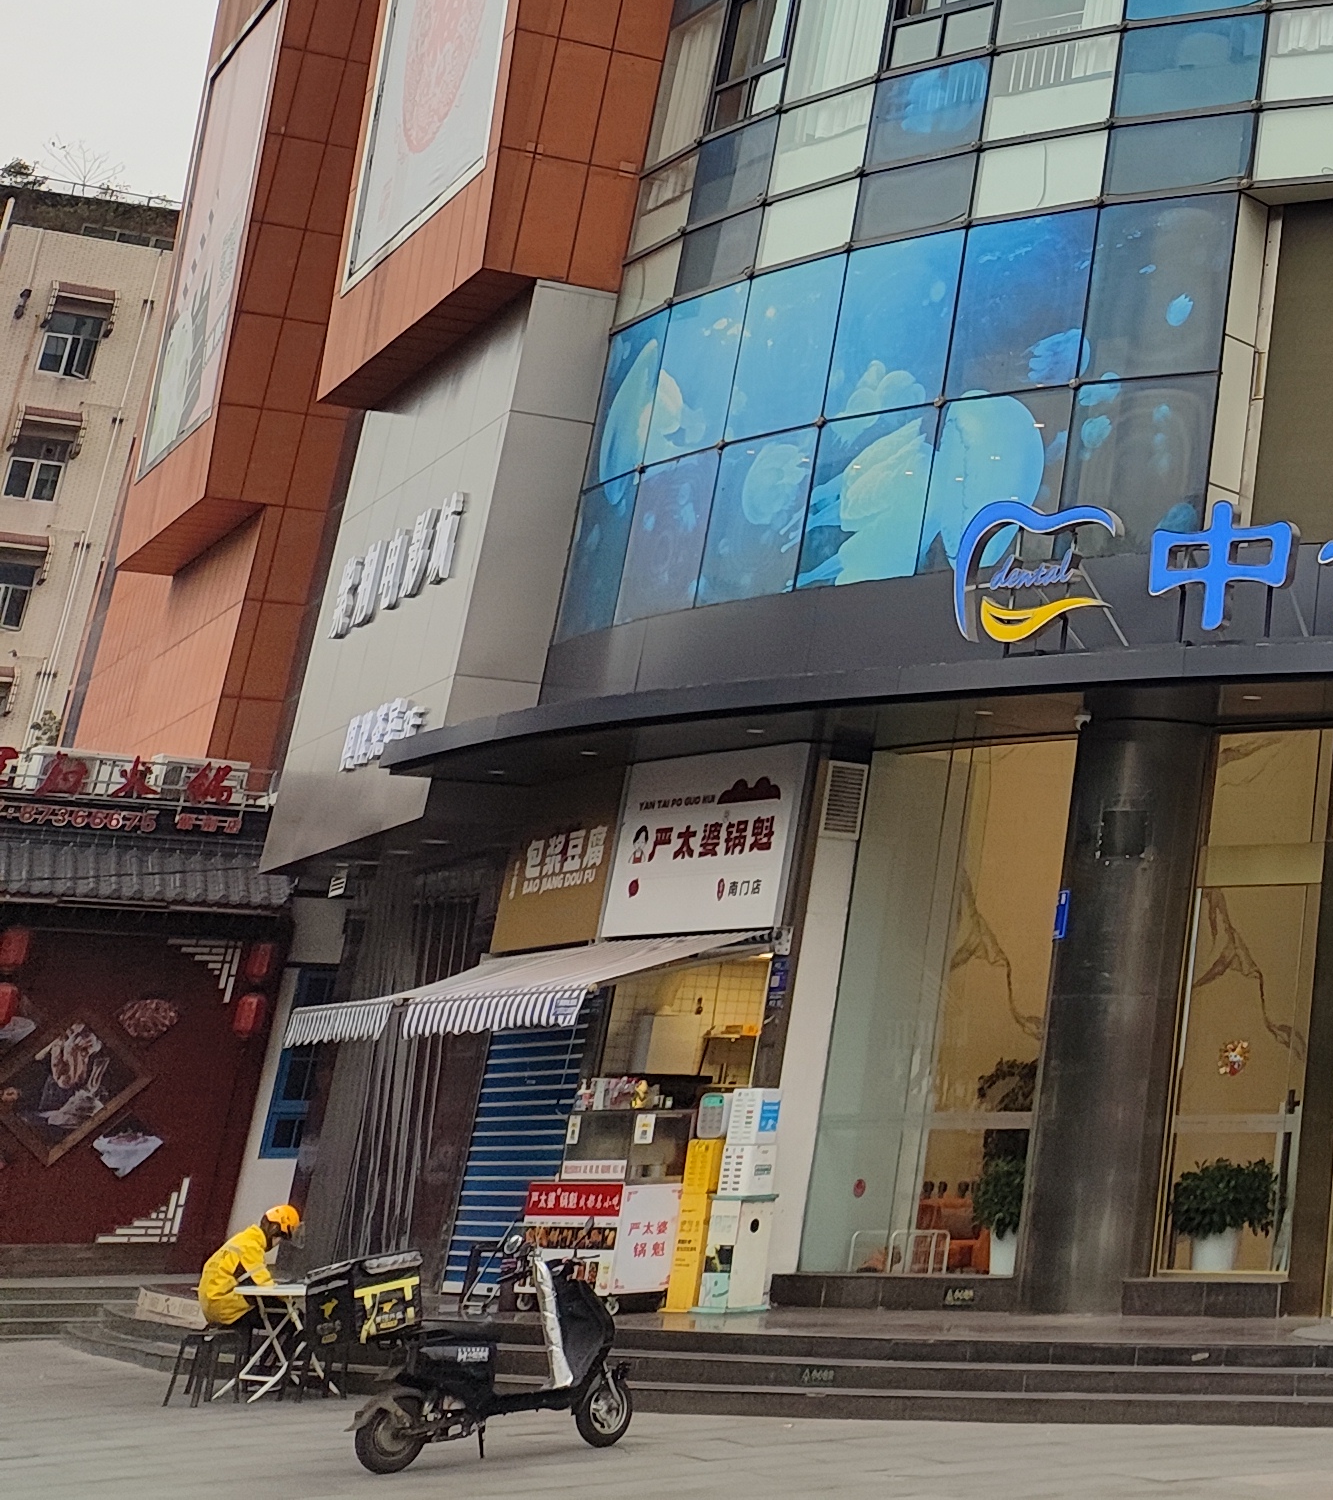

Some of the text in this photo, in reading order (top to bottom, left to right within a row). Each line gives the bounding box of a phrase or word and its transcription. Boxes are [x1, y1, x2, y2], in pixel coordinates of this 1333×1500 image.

[989, 551, 1074, 591] dental
[639, 801, 656, 812] YAN
[647, 815, 775, 862] 严太婆锅魁
[525, 824, 608, 879] 包浆豆腐
[522, 879, 540, 895] BAO
[583, 867, 597, 885] FU
[727, 879, 762, 897] 南门店
[628, 1220, 669, 1237] 严太婆
[632, 1240, 666, 1258] 锅魁
